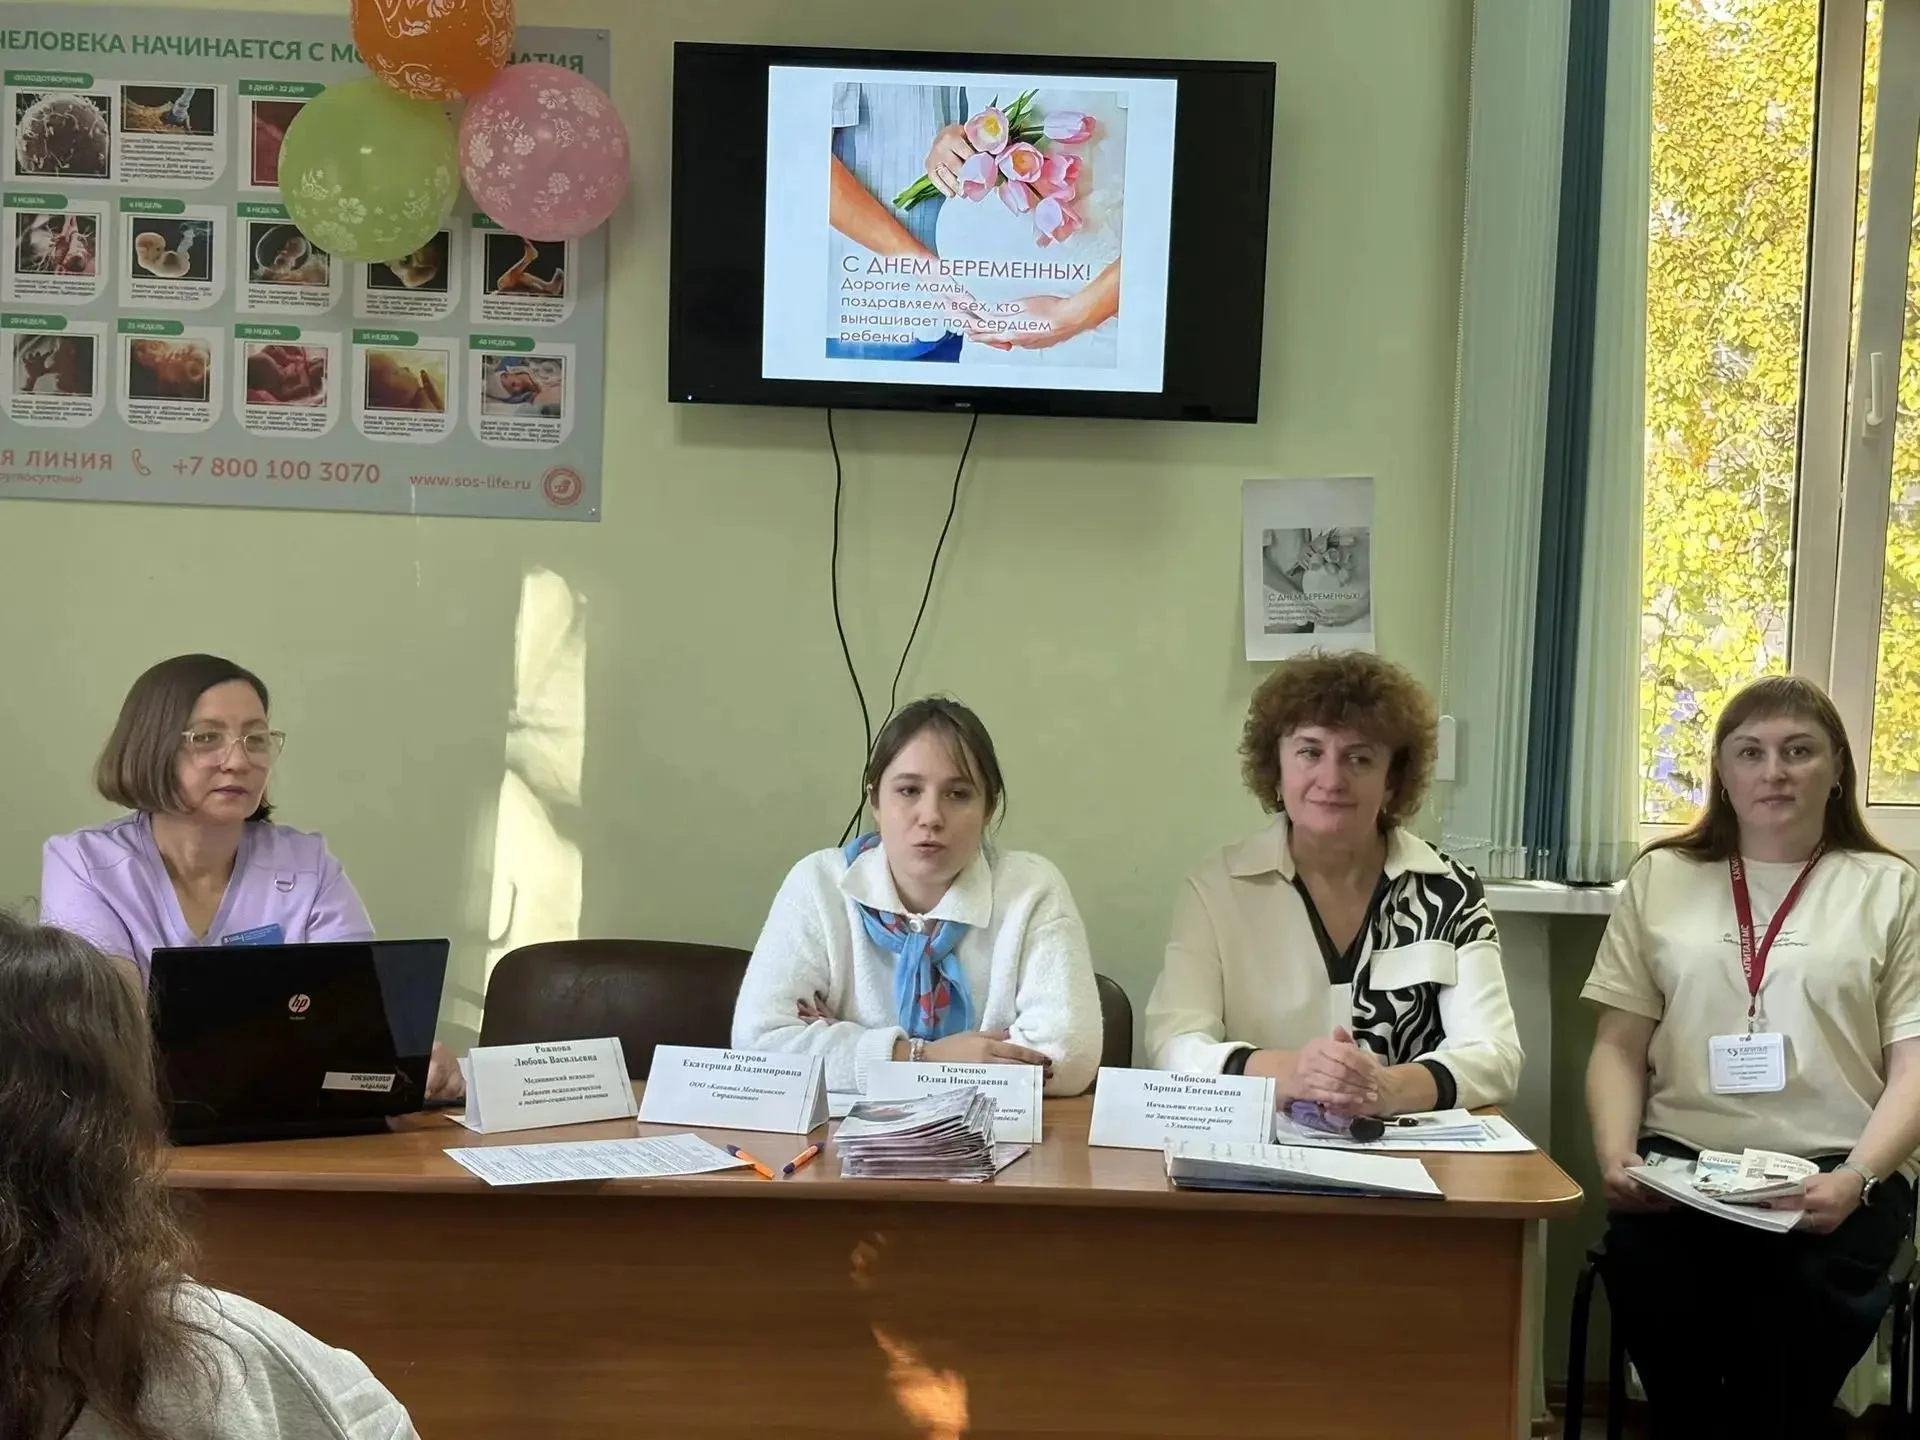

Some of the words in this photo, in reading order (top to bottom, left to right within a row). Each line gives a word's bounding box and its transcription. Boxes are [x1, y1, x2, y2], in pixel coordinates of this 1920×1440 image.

[132, 34, 301, 61] НАЧИНАЕТСЯ
[308, 42, 325, 62] С
[842, 255, 860, 273] С
[866, 257, 932, 276] ДНЕМ
[938, 259, 1091, 281] БЕРЕМЕННЫХ!
[841, 277, 911, 292] Дорогие
[915, 283, 969, 295] мамы,
[841, 297, 946, 311] поздравляем
[951, 301, 991, 313] всех,
[996, 303, 1021, 313] кто
[840, 315, 938, 329] вынашивает
[943, 318, 972, 330] под
[976, 319, 1052, 332] сердцем
[840, 330, 915, 345] ребенка!
[26, 450, 112, 471] ЛИНИЯ
[172, 456, 203, 476] +7
[211, 457, 258, 478] 800
[266, 460, 311, 480] 100
[319, 461, 380, 484] 3070
[409, 475, 532, 491] www.sos-life.ru
[292, 994, 309, 1012] hp
[514, 1057, 548, 1067] Любовь
[549, 1054, 598, 1065] Васильевна
[723, 1051, 767, 1063] Кочурова
[682, 1059, 732, 1071] Екатерина
[734, 1064, 802, 1077] Владимировна
[940, 1064, 987, 1075] Ткаченко
[917, 1075, 947, 1084] Юлия
[950, 1076, 1009, 1086] Николаевна
[1170, 1073, 1217, 1084] Чибисова
[1143, 1082, 1182, 1094] Марина
[1185, 1085, 1241, 1097] Евгеньевна
